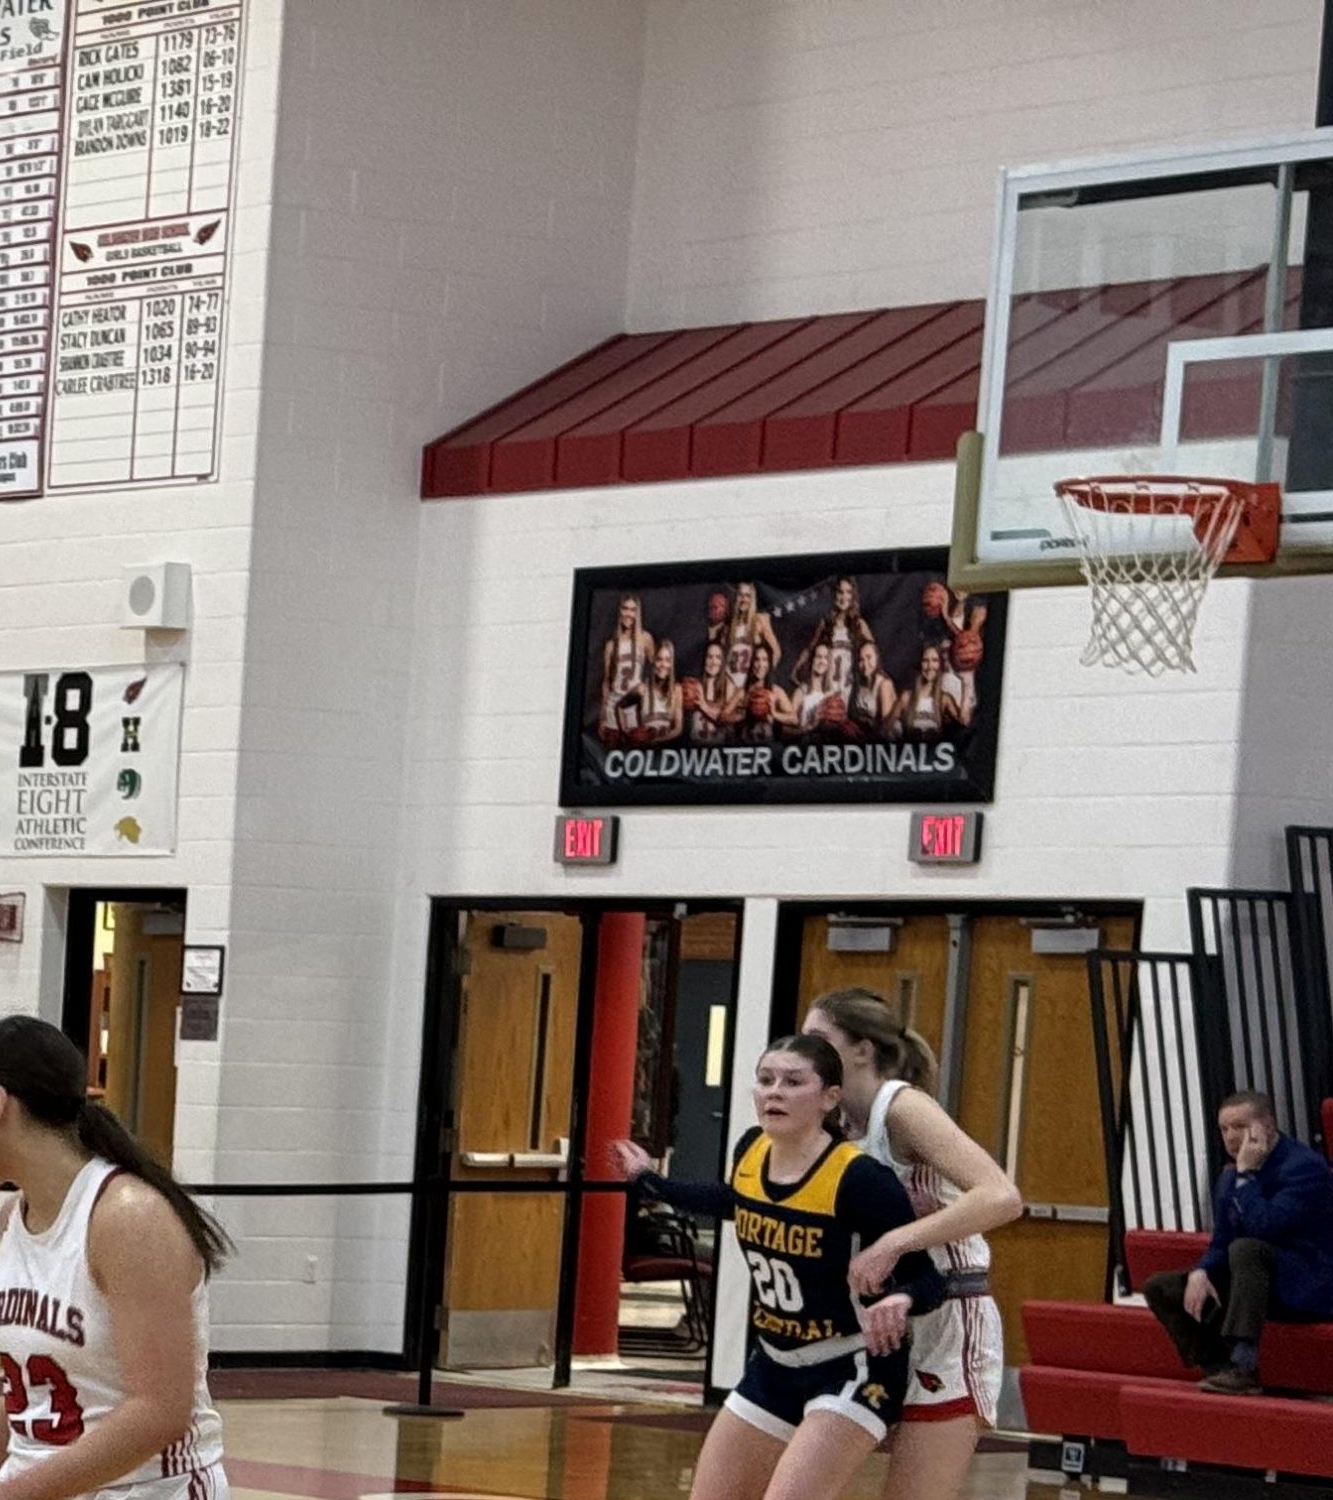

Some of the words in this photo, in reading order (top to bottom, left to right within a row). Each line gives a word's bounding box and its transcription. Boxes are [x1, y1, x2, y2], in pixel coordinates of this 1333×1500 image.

[0, 42, 43, 61] Field
[122, 266, 158, 282] POINT
[161, 263, 193, 278] CLUB
[603, 746, 774, 780] COLDWATER
[781, 741, 956, 776] CARDINALS
[17, 772, 88, 788] INTERSTATE
[17, 789, 87, 816] EIGHT
[15, 817, 86, 835] ATHLETIC
[921, 816, 966, 857] EXIT
[14, 836, 86, 851] CONFERENCE
[564, 819, 604, 858] EXIT
[746, 1249, 804, 1312] 20
